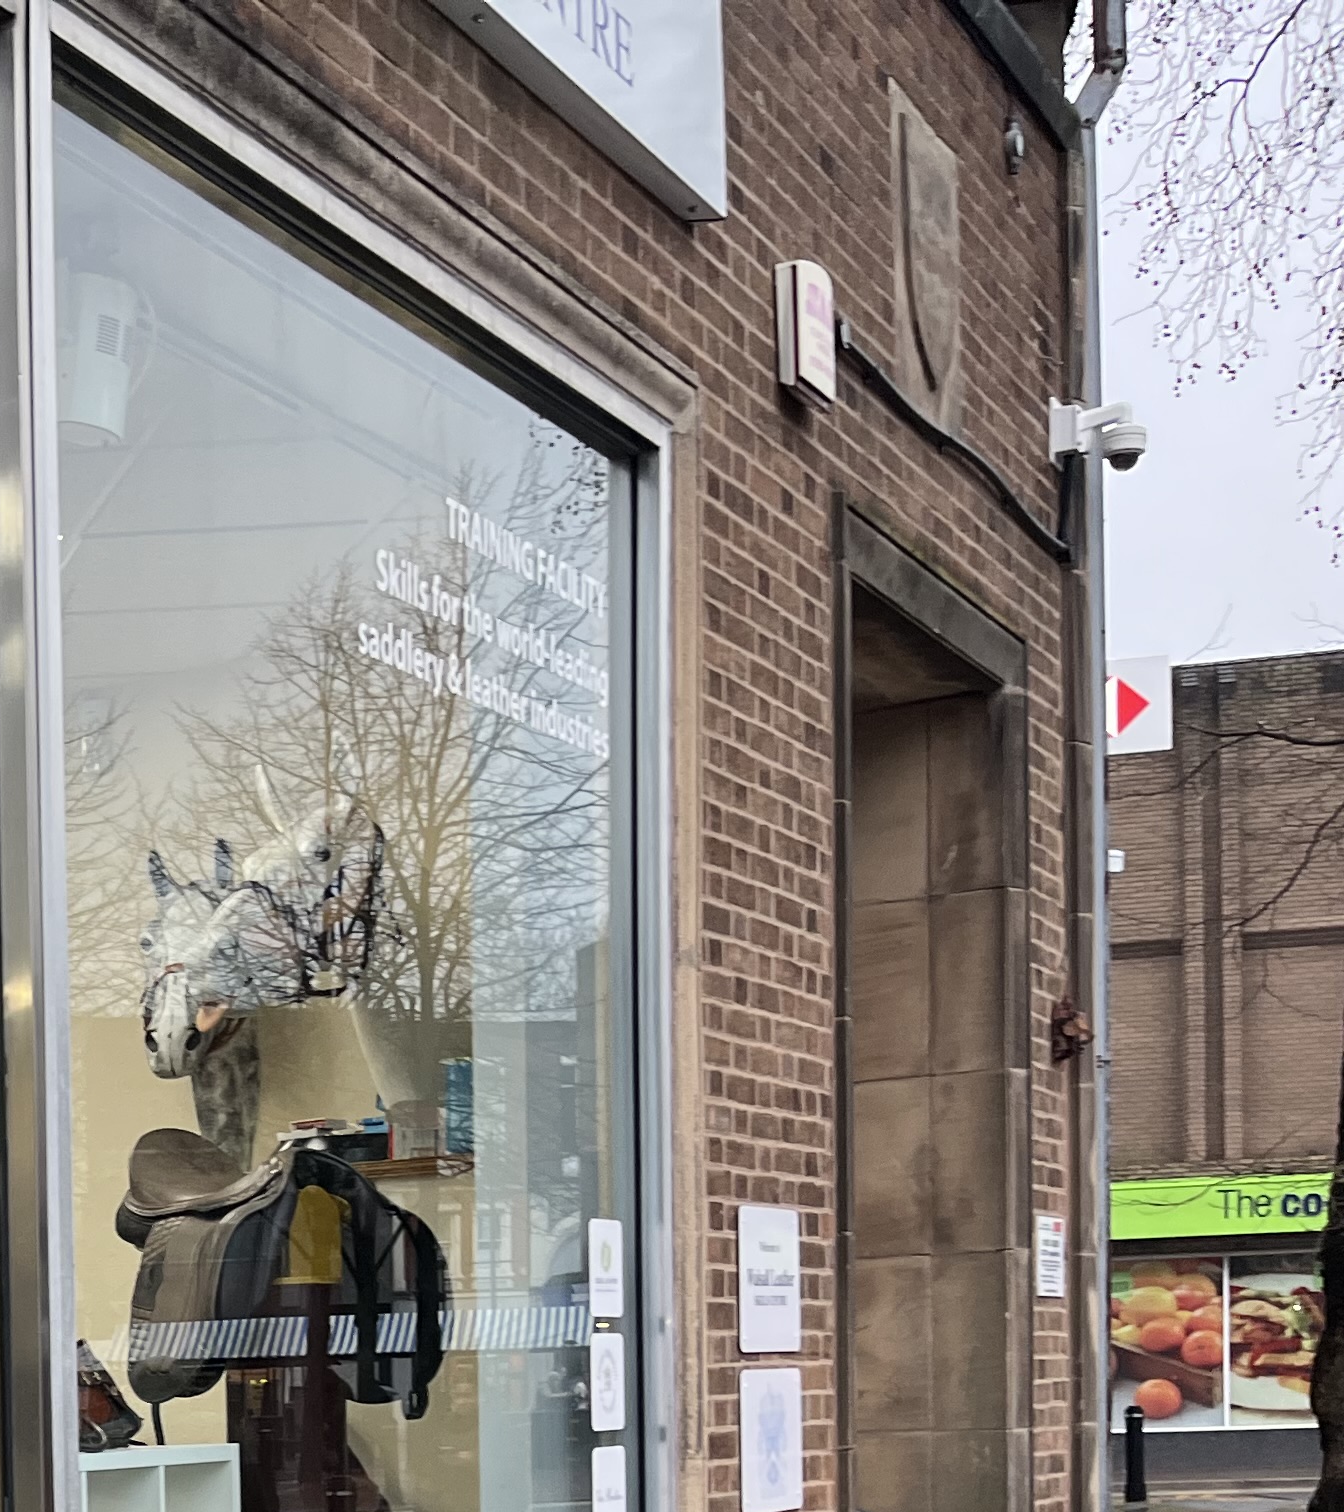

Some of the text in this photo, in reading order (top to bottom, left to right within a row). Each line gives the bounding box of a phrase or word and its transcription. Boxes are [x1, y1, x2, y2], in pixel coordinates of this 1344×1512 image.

[542, 0, 634, 87] TRE
[376, 548, 428, 613] Skills
[431, 574, 463, 626] for
[463, 593, 493, 643] the
[445, 496, 608, 618] TRAINING FACILITY
[358, 622, 444, 698] saddlery
[447, 652, 463, 696] &
[464, 658, 529, 723] leather
[1216, 1188, 1272, 1219] The
